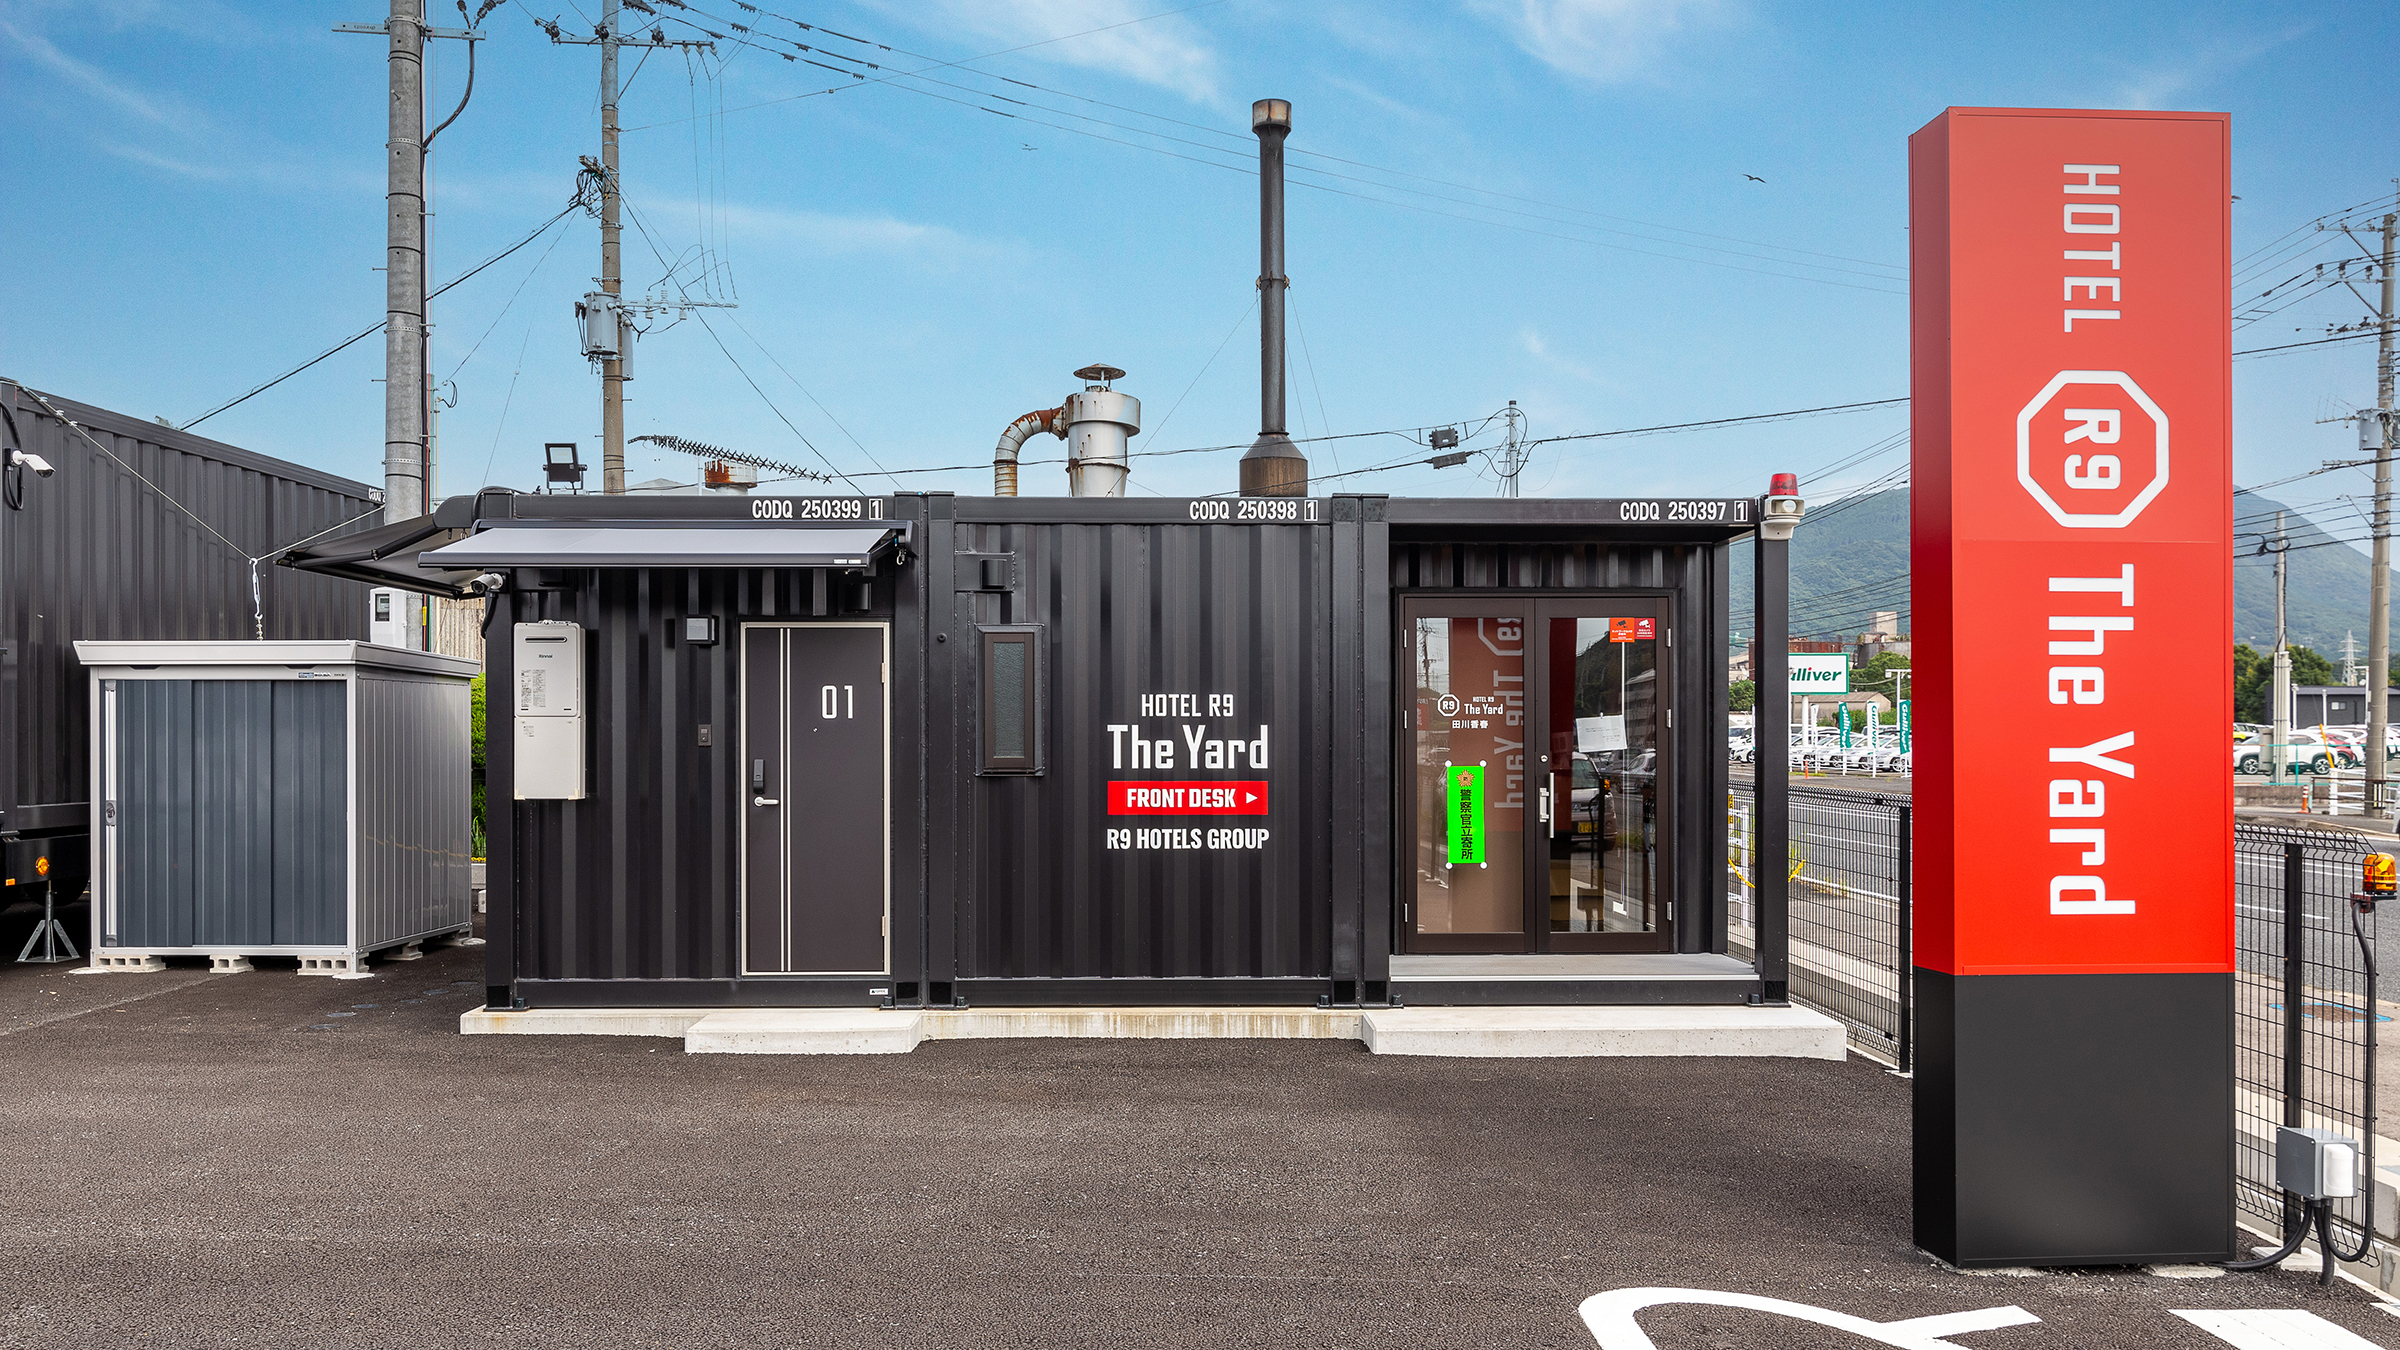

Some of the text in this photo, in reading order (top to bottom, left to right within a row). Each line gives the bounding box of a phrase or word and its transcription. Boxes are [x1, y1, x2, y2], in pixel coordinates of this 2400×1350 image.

[2063, 163, 2121, 333] HOTEL
[2064, 408, 2121, 490] R9
[752, 499, 793, 519] CODQ
[801, 499, 861, 519] 250399
[1189, 500, 1229, 520] CODQ
[1237, 500, 1297, 520] 250398
[1620, 501, 1660, 521] CODQ
[1668, 501, 1727, 521] 250397
[821, 685, 854, 719] 01
[1141, 693, 1234, 717] HOTEL R9
[1442, 700, 1455, 710] R9
[1463, 703, 1504, 715] The Yard
[1871, 705, 1879, 749] Gulliver
[2048, 563, 2136, 915] The Yard
[1106, 724, 1269, 769] The Yard
[1127, 788, 1236, 808] FRONT DESK
[1459, 789, 1473, 860] 警察官立寄所
[1106, 828, 1270, 850] R9 HOTELS GROUP
